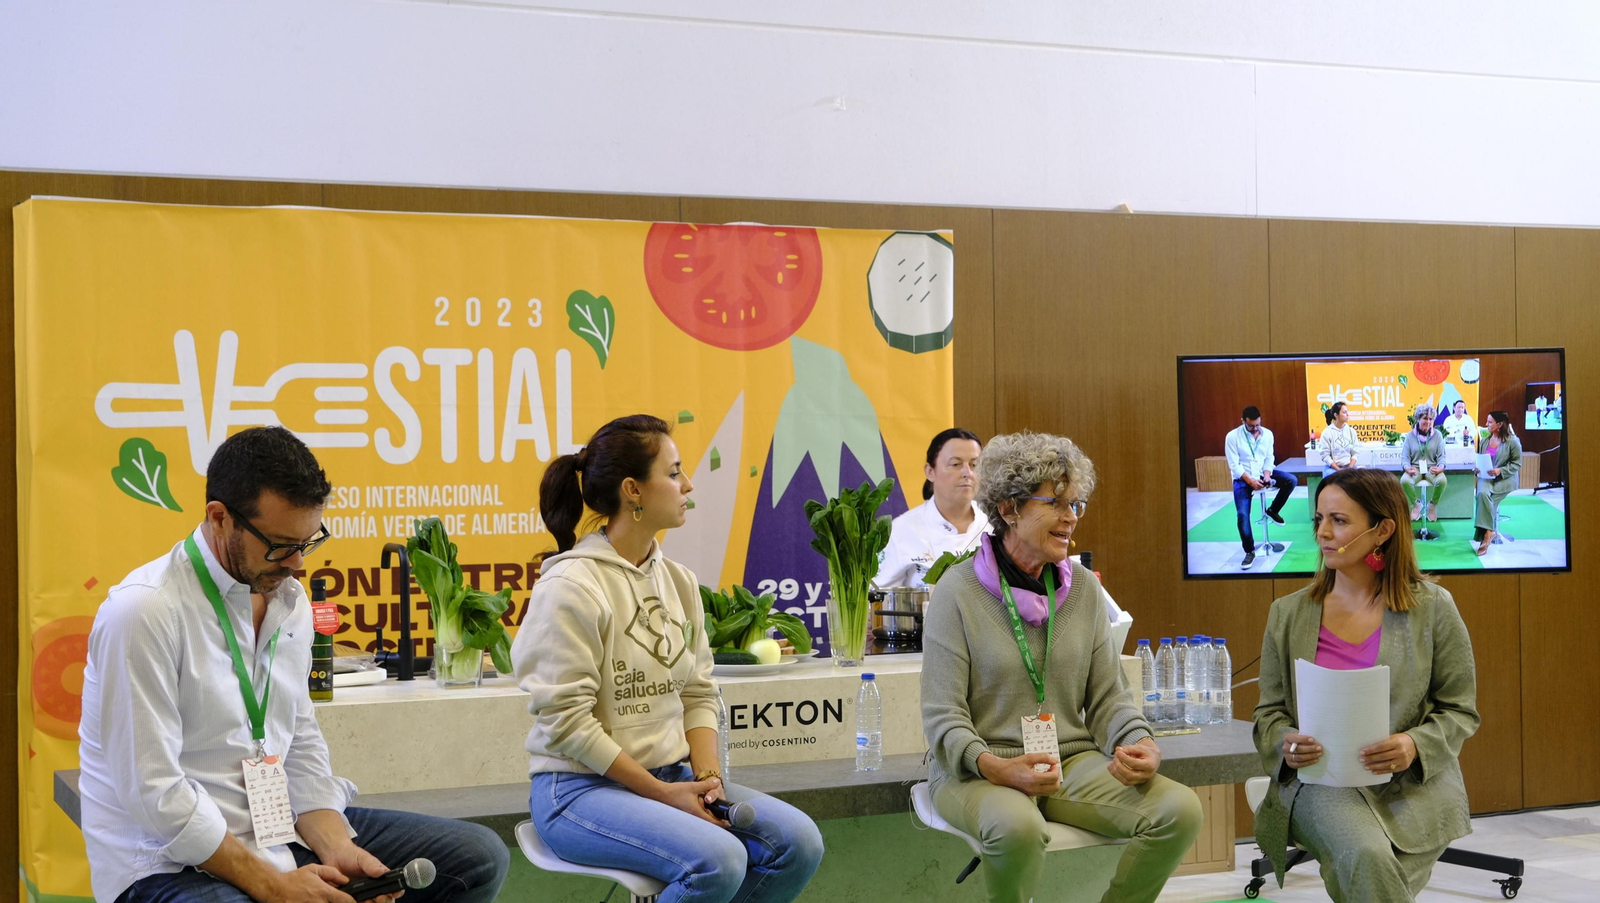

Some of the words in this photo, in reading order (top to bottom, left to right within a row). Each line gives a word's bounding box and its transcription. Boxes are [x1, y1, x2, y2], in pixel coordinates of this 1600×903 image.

[434, 296, 544, 327] 2023
[365, 484, 503, 508] INTERNACIONAL
[444, 513, 467, 536] DE
[471, 507, 546, 535] ALMERÍA
[757, 578, 799, 600] 29
[804, 582, 823, 607] y
[612, 658, 627, 672] la
[613, 668, 646, 686] caja
[730, 698, 843, 730] EKTON
[748, 739, 760, 750] by
[762, 736, 817, 747] COSENTINO
